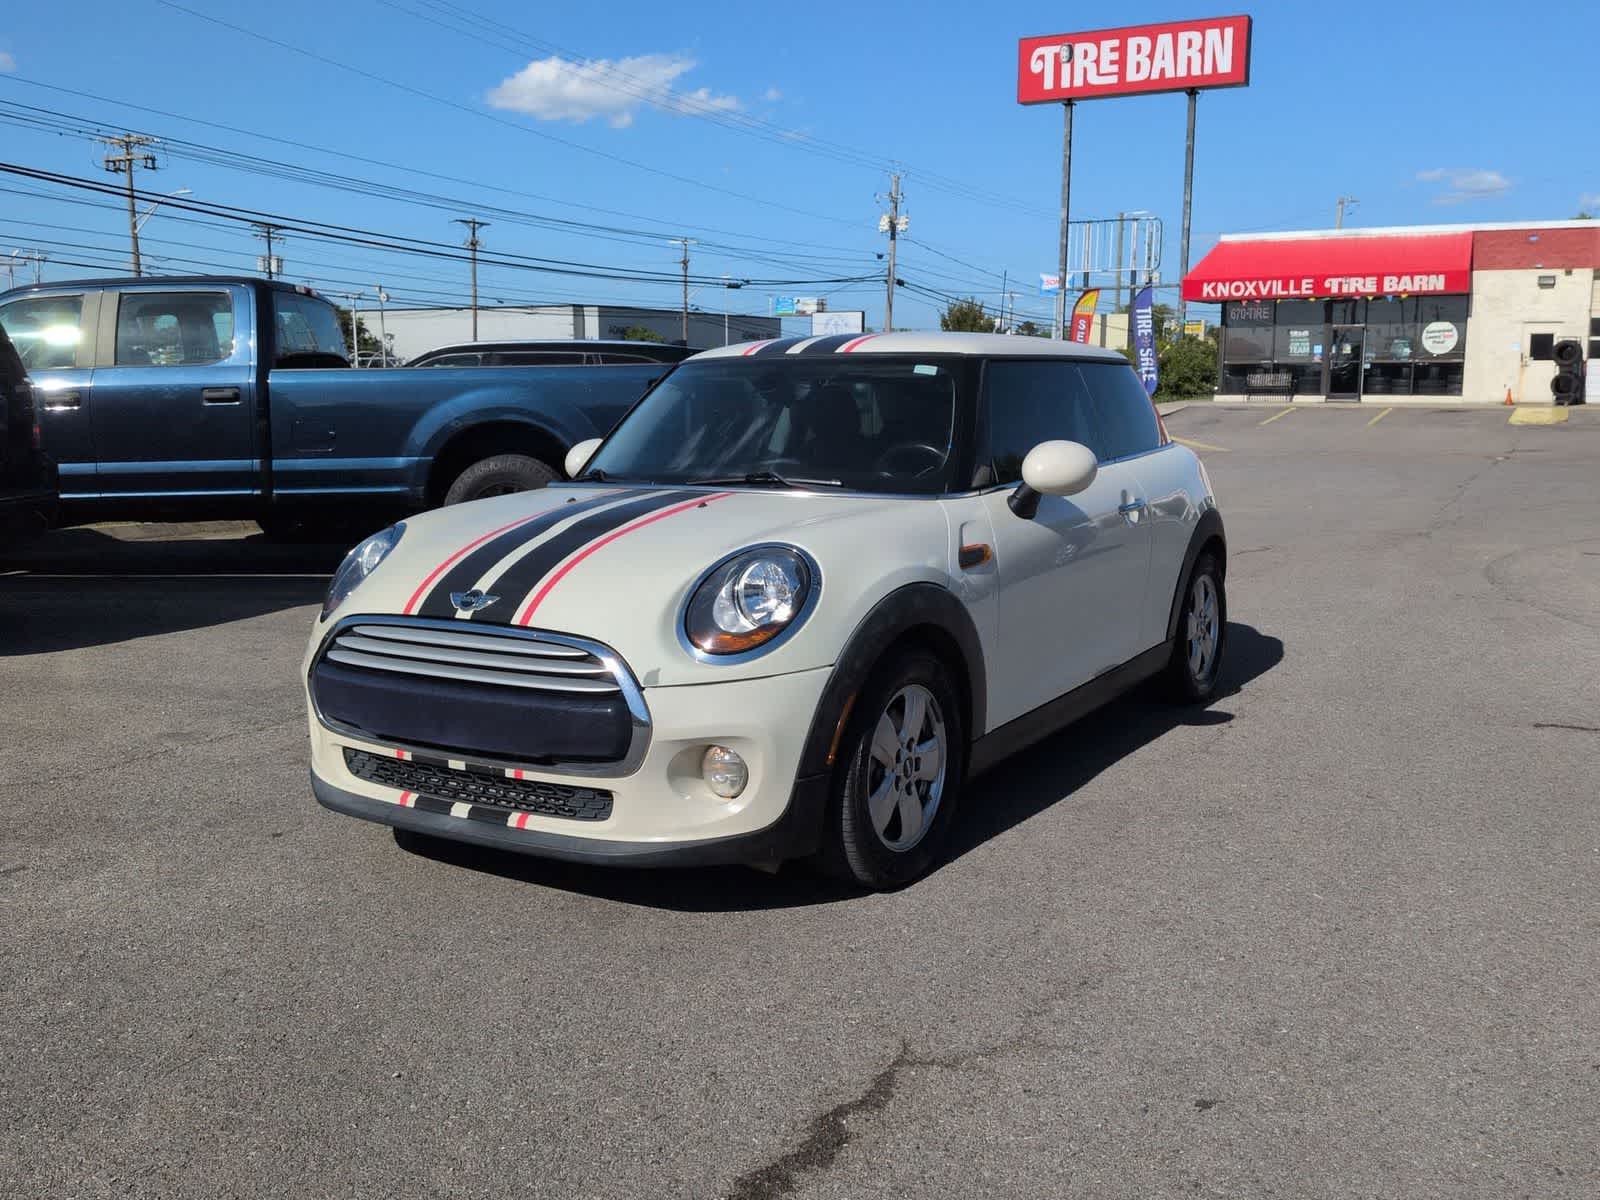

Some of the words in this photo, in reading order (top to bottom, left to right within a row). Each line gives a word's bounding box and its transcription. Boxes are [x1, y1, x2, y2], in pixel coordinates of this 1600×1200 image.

[1030, 38, 1120, 90] TIRE
[1126, 27, 1234, 82] BARN
[1202, 279, 1315, 297] KNOXVILLE
[1324, 276, 1378, 293] TIRE
[1383, 274, 1446, 292] BARN
[1135, 305, 1153, 337] TIRE
[1139, 347, 1157, 382] SALE
